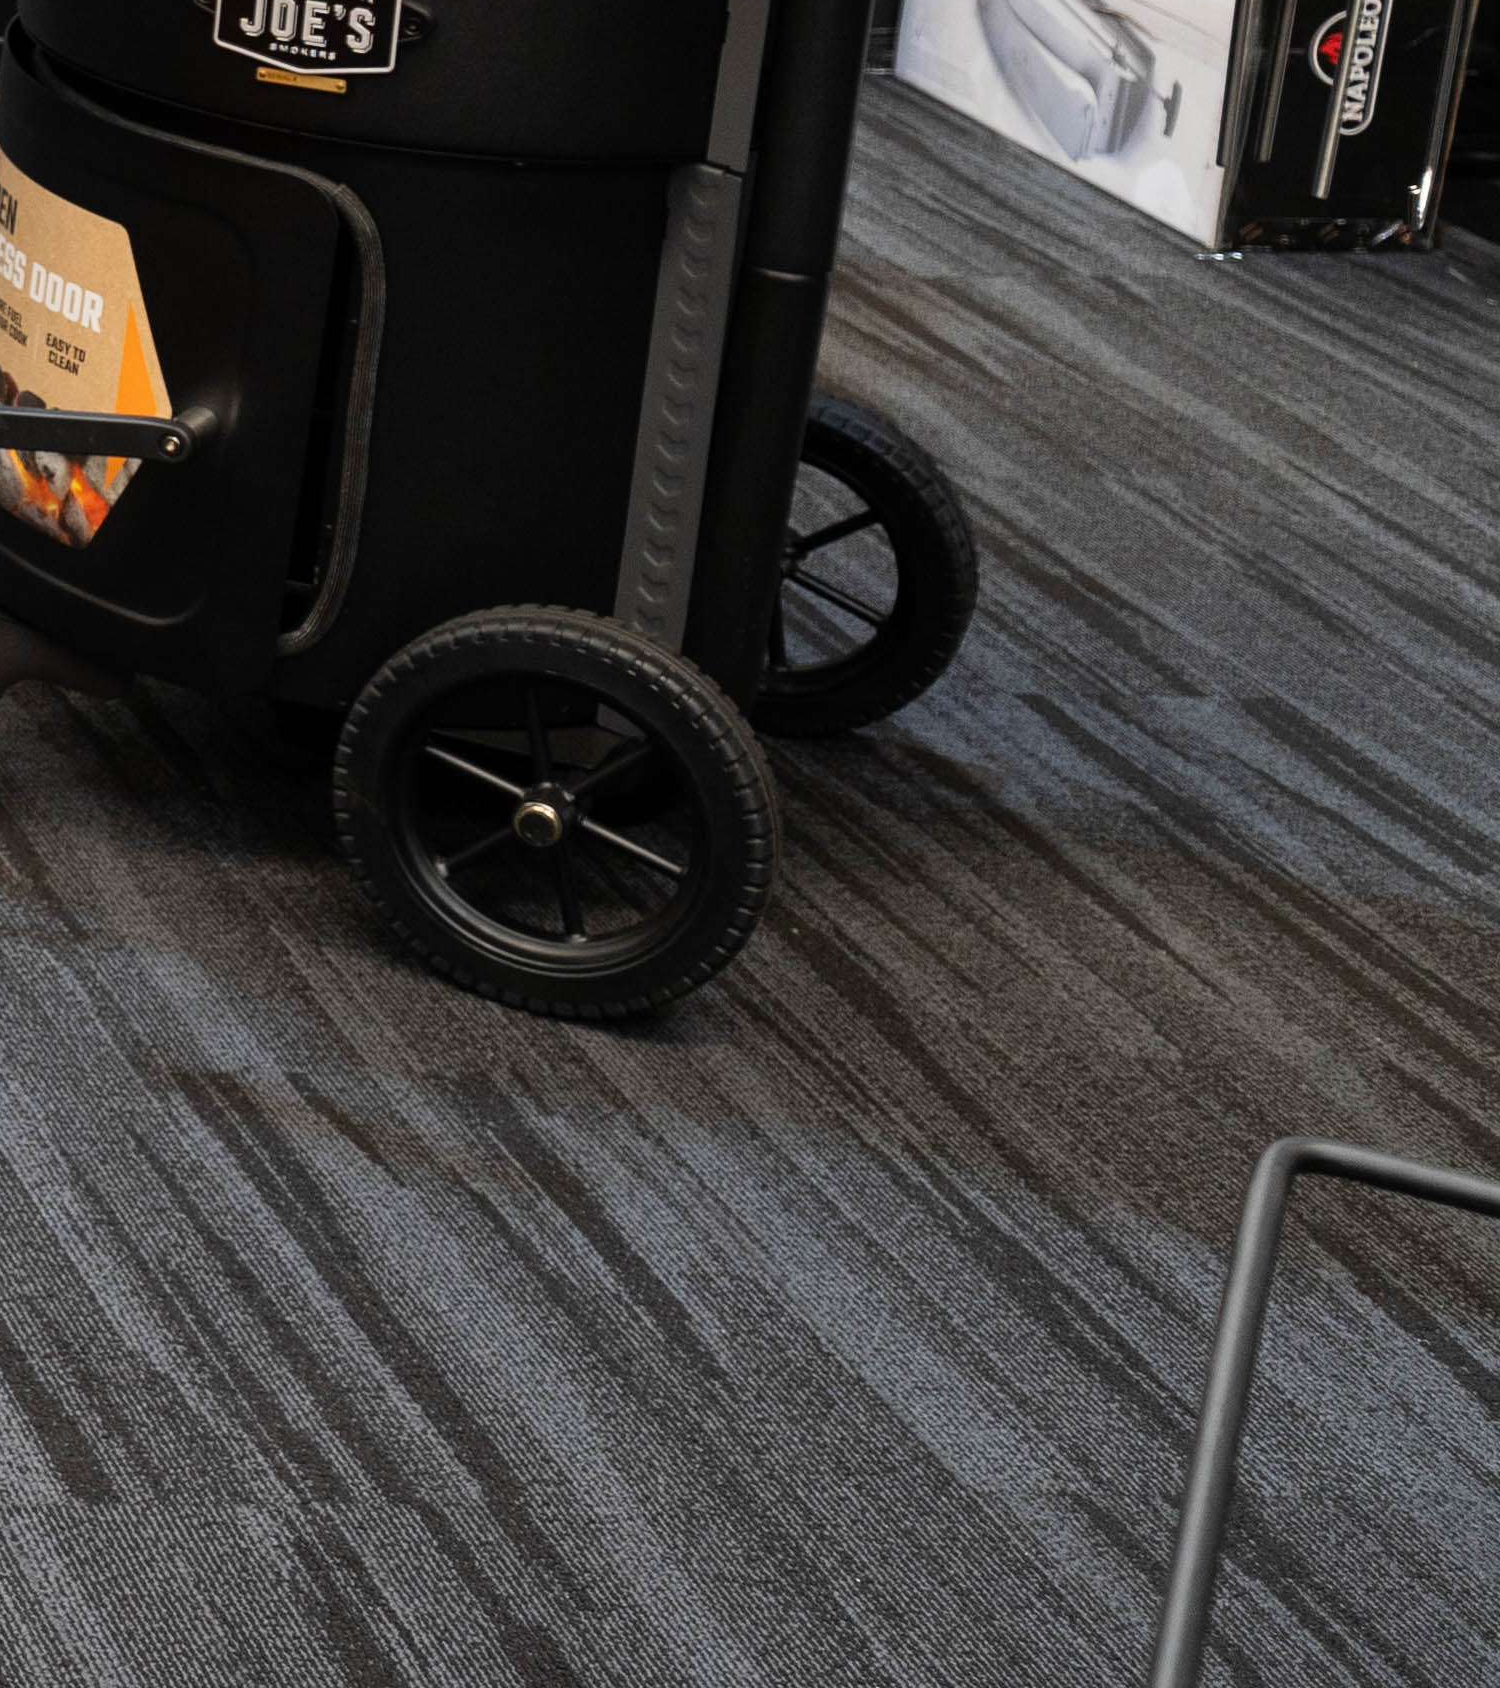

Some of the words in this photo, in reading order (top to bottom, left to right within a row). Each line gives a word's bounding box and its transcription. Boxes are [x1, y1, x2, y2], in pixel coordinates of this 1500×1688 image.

[268, 42, 337, 61] SMOKERS
[28, 261, 104, 334] DOOR
[8, 305, 22, 328] FUEL
[8, 323, 29, 347] COOK
[46, 332, 72, 353] EASY
[73, 345, 86, 363] TO
[48, 350, 80, 376] CLEAN
